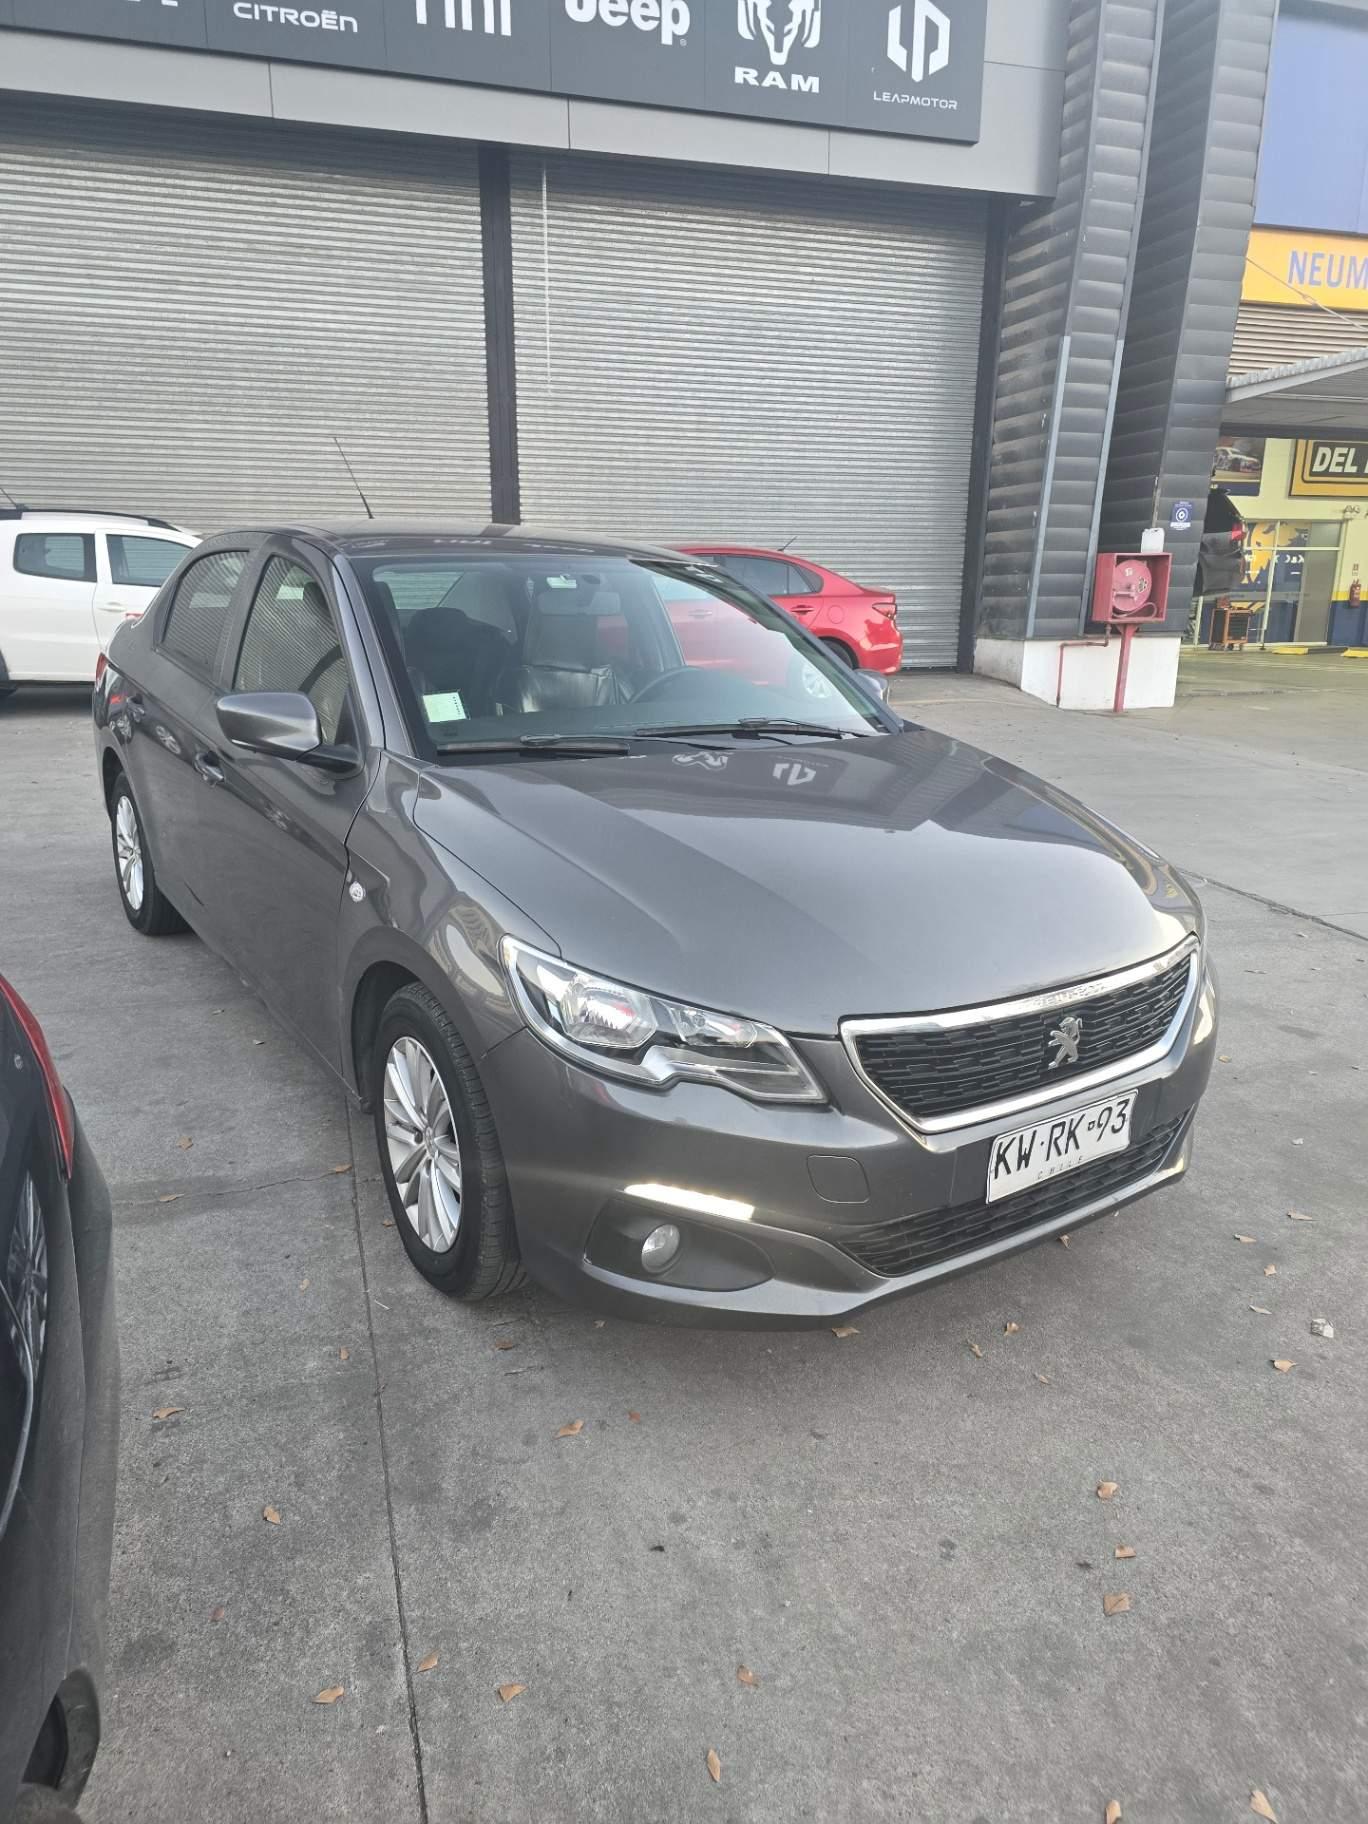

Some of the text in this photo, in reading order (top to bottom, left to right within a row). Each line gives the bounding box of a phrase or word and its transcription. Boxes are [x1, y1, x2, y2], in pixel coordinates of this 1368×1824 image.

[734, 66, 820, 93] RAM
[873, 90, 958, 110] LEAPMOTOR
[1288, 250, 1368, 289] NEUM
[1312, 446, 1357, 473] DEL
